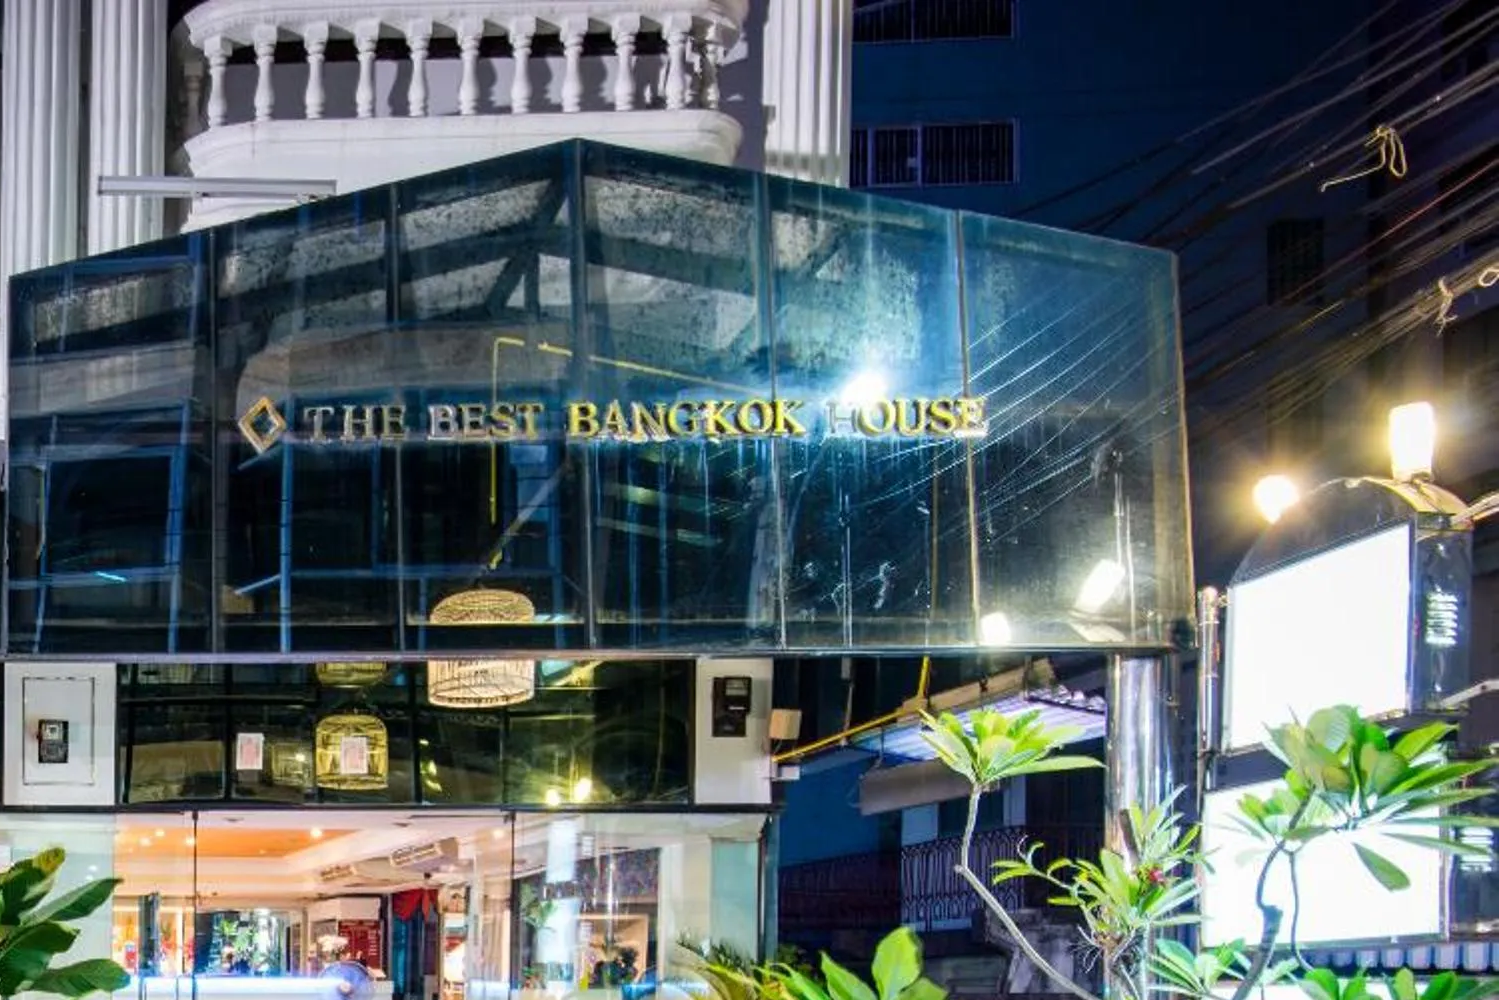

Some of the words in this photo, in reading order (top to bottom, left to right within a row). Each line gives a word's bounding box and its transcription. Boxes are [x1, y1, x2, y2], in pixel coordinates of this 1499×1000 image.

[304, 403, 406, 443] THE
[427, 402, 545, 441] BEST
[567, 398, 806, 441] BANGKOK
[824, 397, 989, 439] HOUSE
